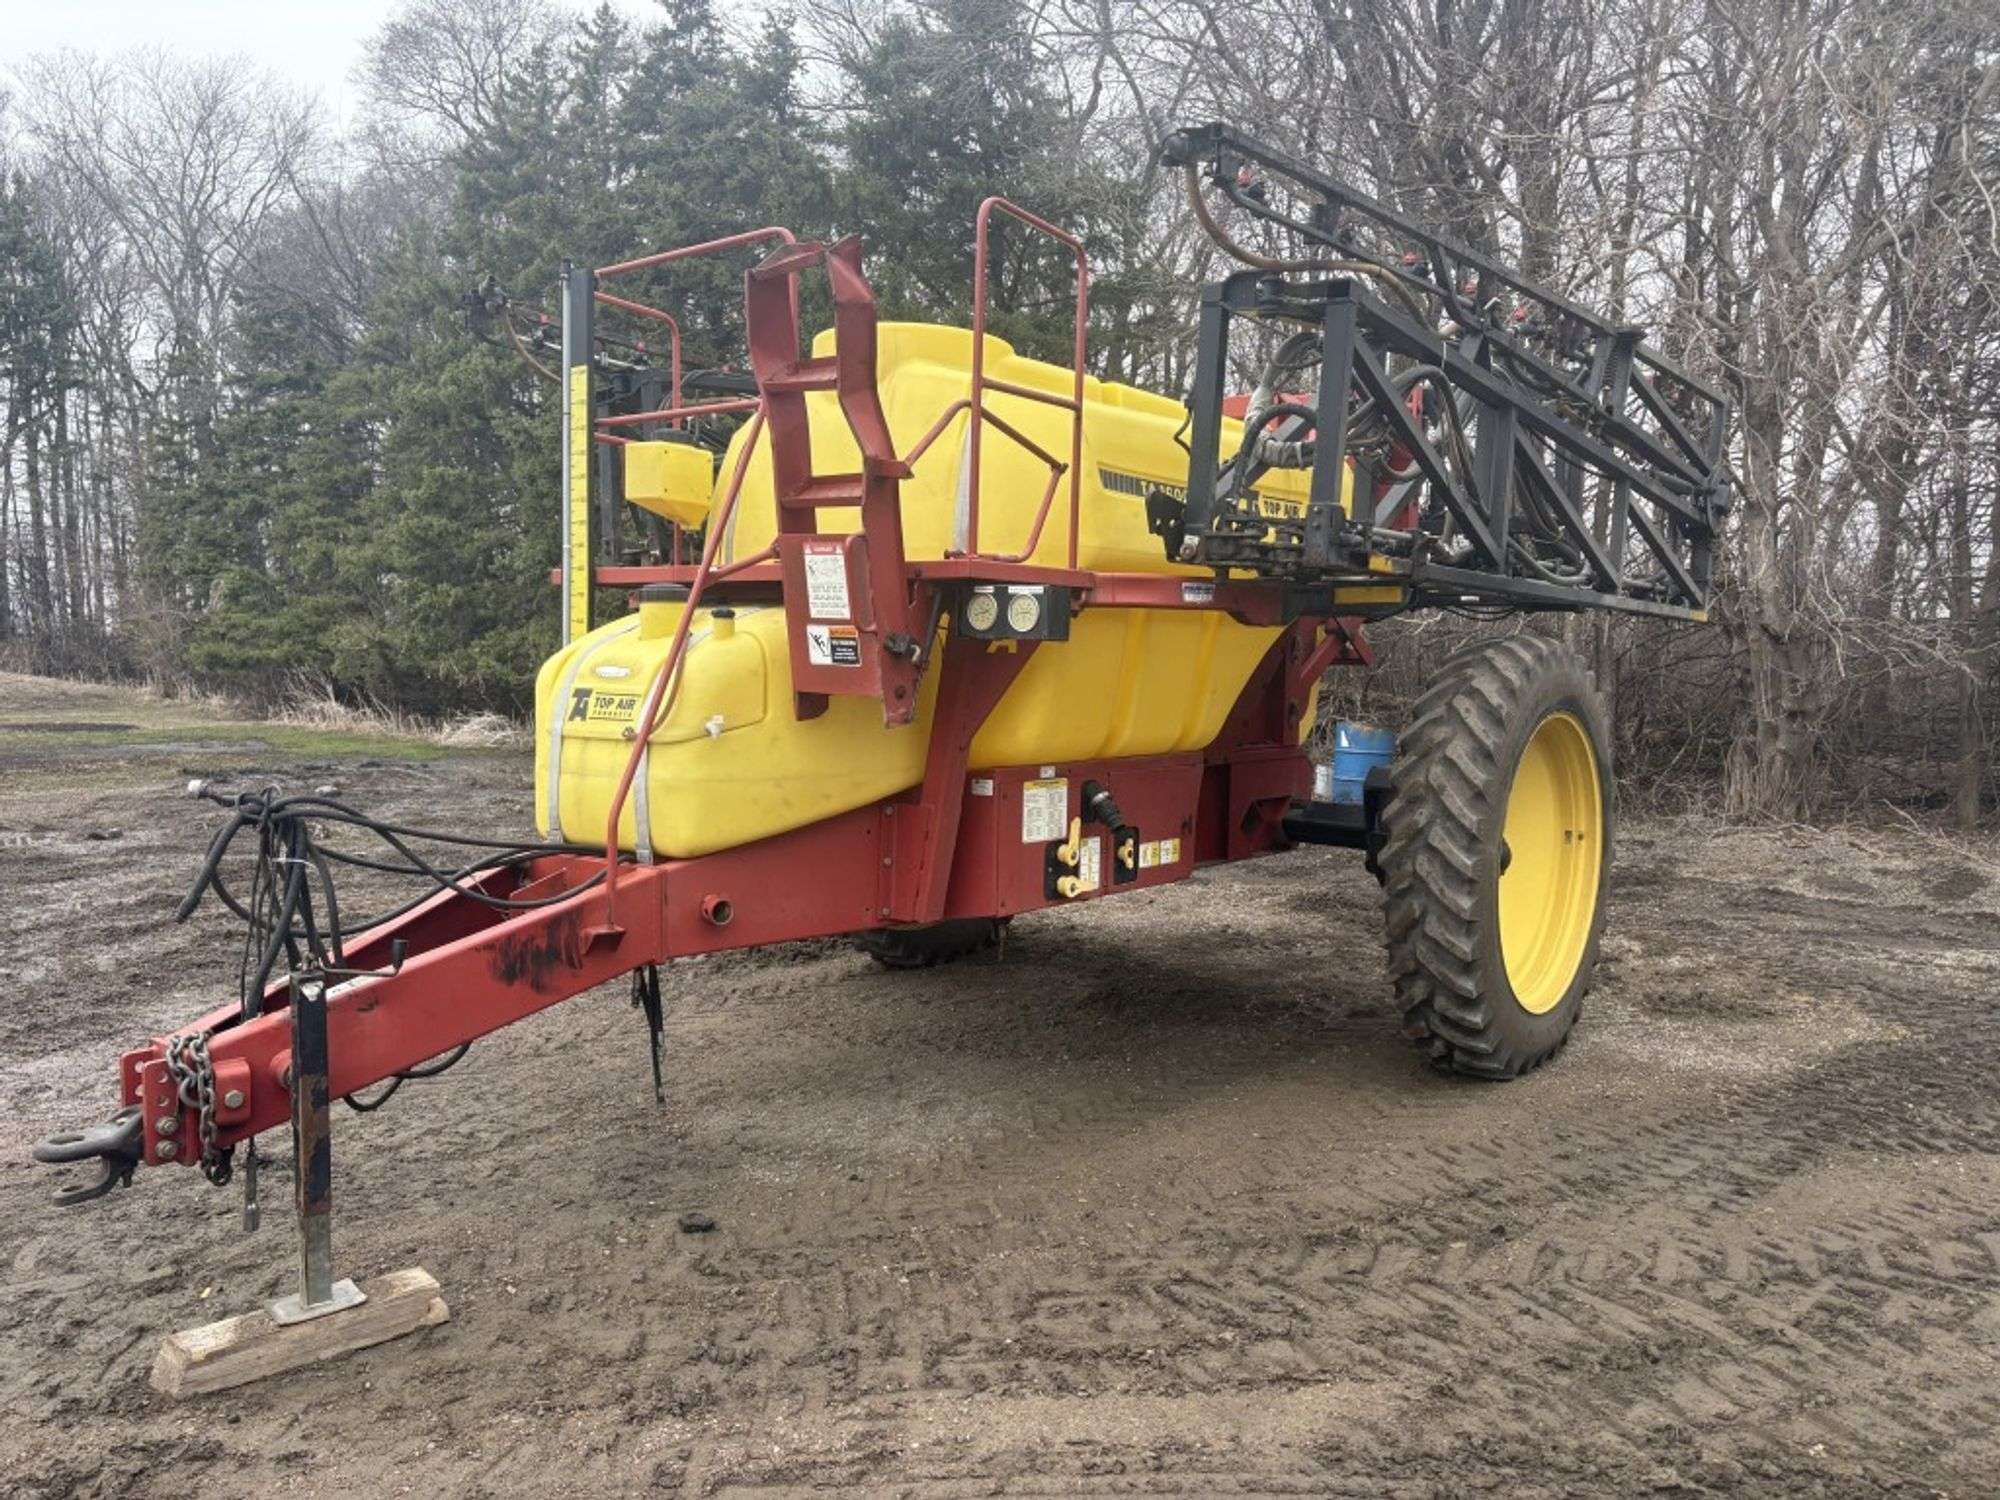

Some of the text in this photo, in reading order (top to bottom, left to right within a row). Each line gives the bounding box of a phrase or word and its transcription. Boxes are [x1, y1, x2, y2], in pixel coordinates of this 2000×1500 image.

[1263, 500, 1281, 515] TOP
[594, 697, 636, 710] TOP AIR
